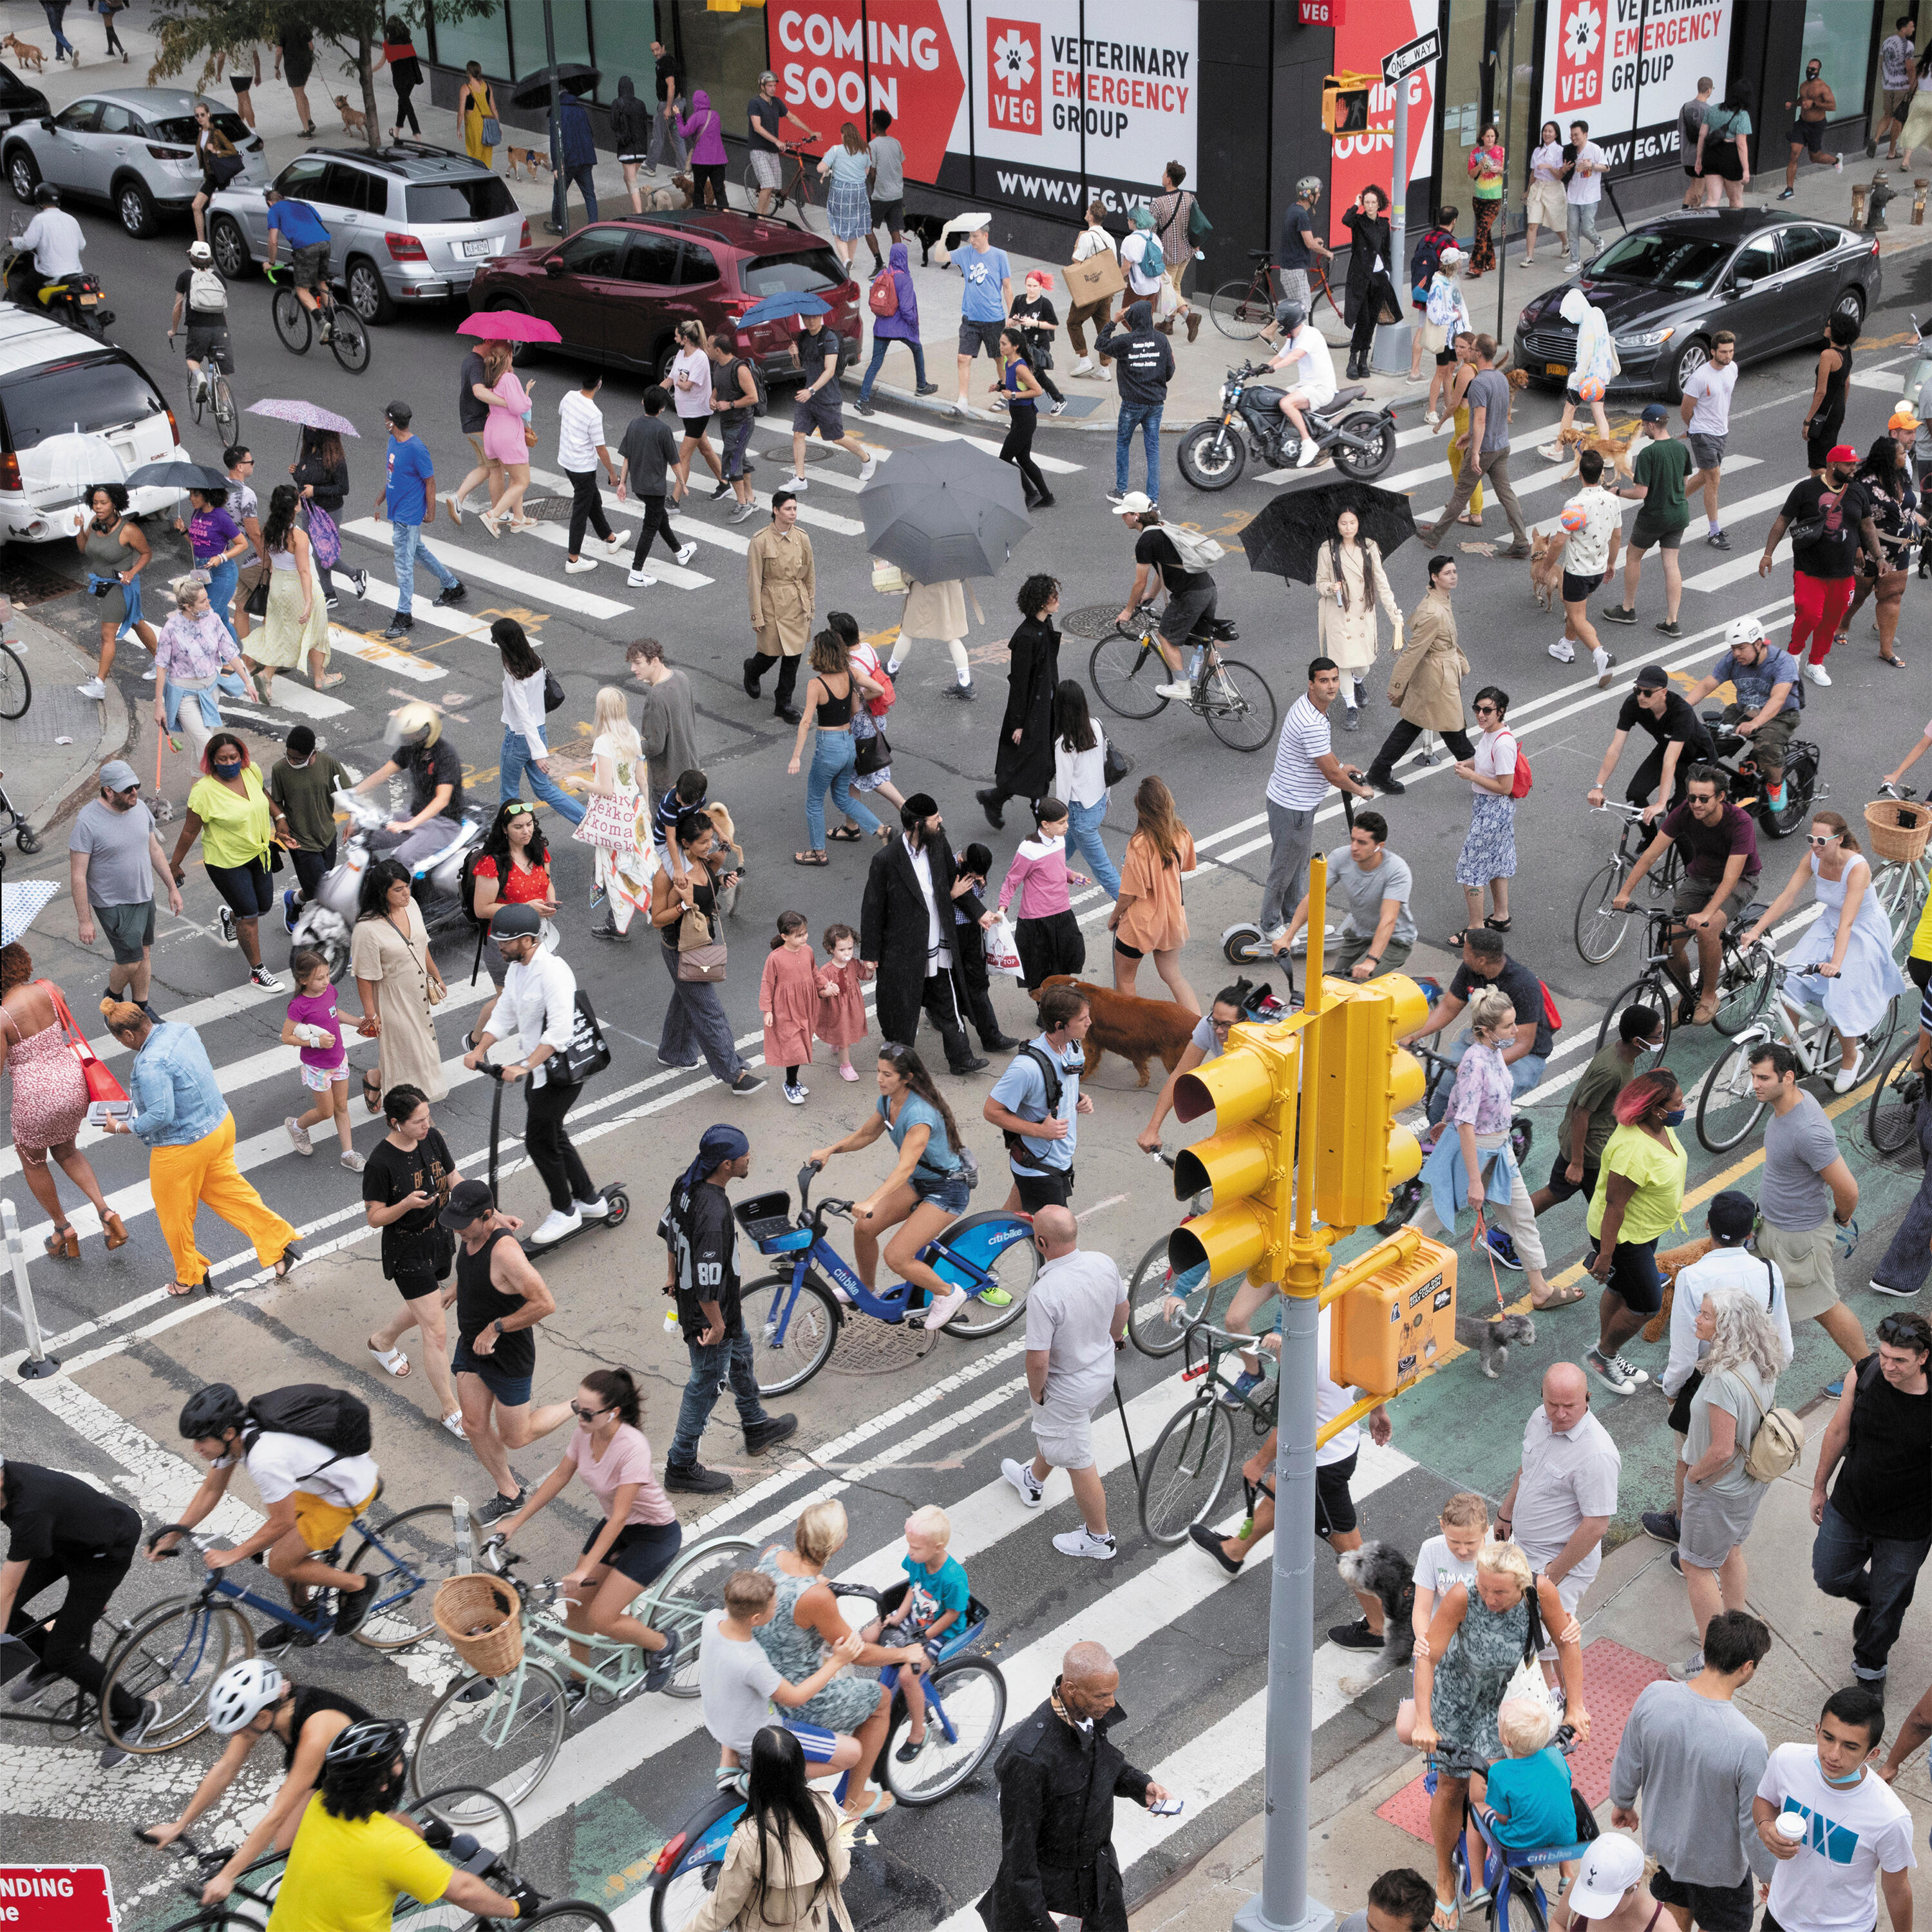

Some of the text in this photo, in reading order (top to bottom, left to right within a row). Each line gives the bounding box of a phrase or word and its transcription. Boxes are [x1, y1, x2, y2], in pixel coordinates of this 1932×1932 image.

[1302, 3, 1329, 21] VEG
[779, 10, 939, 71] COMING
[1614, 10, 1722, 58] EMERGENCY
[1051, 35, 1189, 79] VETERINARY
[1391, 41, 1432, 73] ONE WAY
[1562, 70, 1596, 103] VEG
[1612, 54, 1674, 92] GROUP
[784, 63, 898, 120] SOON
[1052, 70, 1189, 114] EMERGENCY
[994, 94, 1035, 125] VEG
[1053, 104, 1128, 138] GROUP
[151, 451, 168, 460] GMC
[1792, 526, 1810, 536] GUCCI
[1003, 1229, 1023, 1240] bike
[697, 1263, 722, 1285] 80
[842, 1278, 860, 1296] bike
[1410, 1274, 1442, 1302] BIG CHEF DOG
[1410, 1296, 1422, 1309] STAY
[1422, 1282, 1441, 1301] COOKIN
[1528, 1850, 1572, 1863] citi bike
